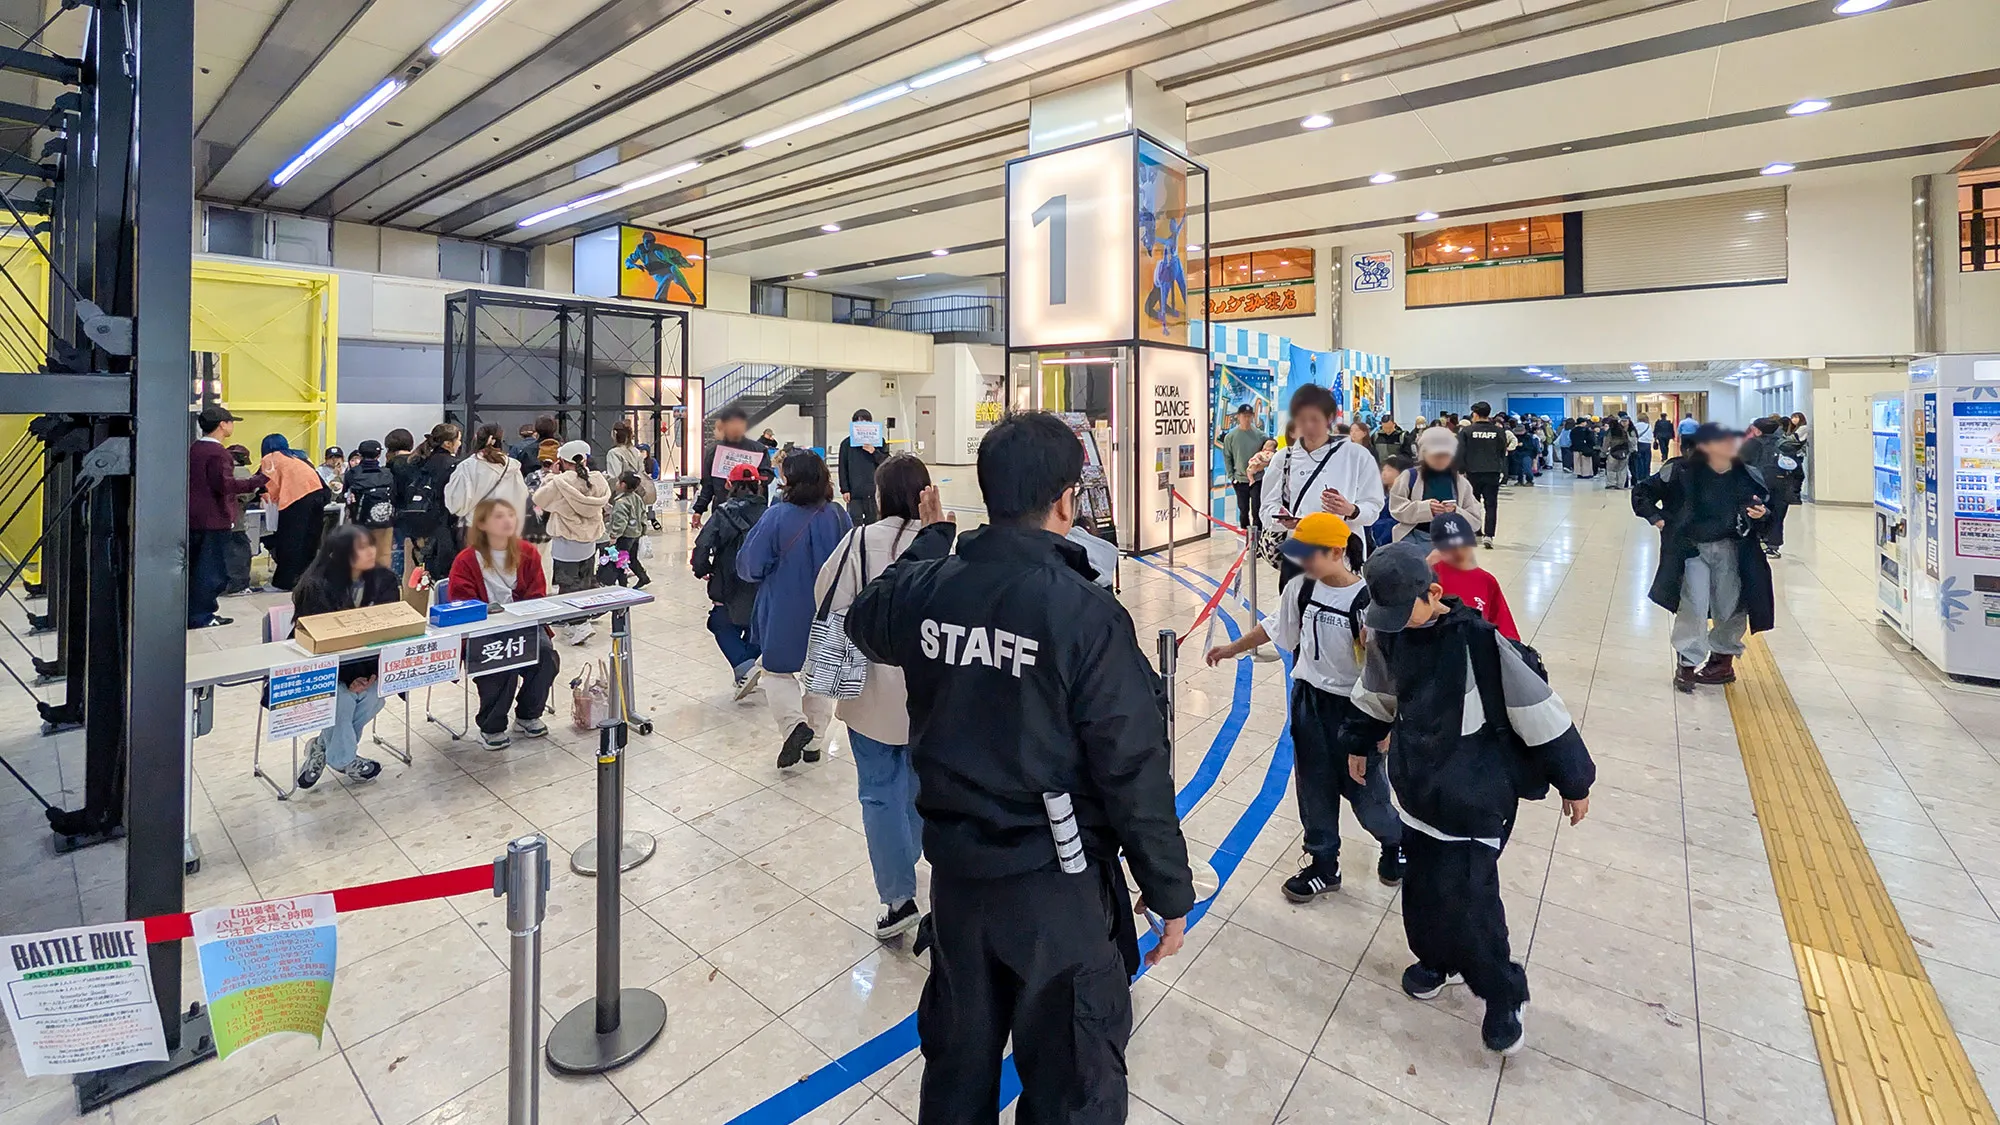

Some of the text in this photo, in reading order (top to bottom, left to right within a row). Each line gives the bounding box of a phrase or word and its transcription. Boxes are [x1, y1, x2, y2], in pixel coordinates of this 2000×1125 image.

[1031, 194, 1067, 305] 1
[1155, 384, 1180, 398] KOKURA
[1155, 401, 1189, 417] DANCE
[1155, 419, 1196, 436] STATION
[1472, 431, 1497, 439] STAFF
[404, 641, 439, 656] お客様
[481, 635, 527, 664] 受付
[920, 618, 1039, 678] STAFF
[11, 930, 138, 971] BATTLE RULE
